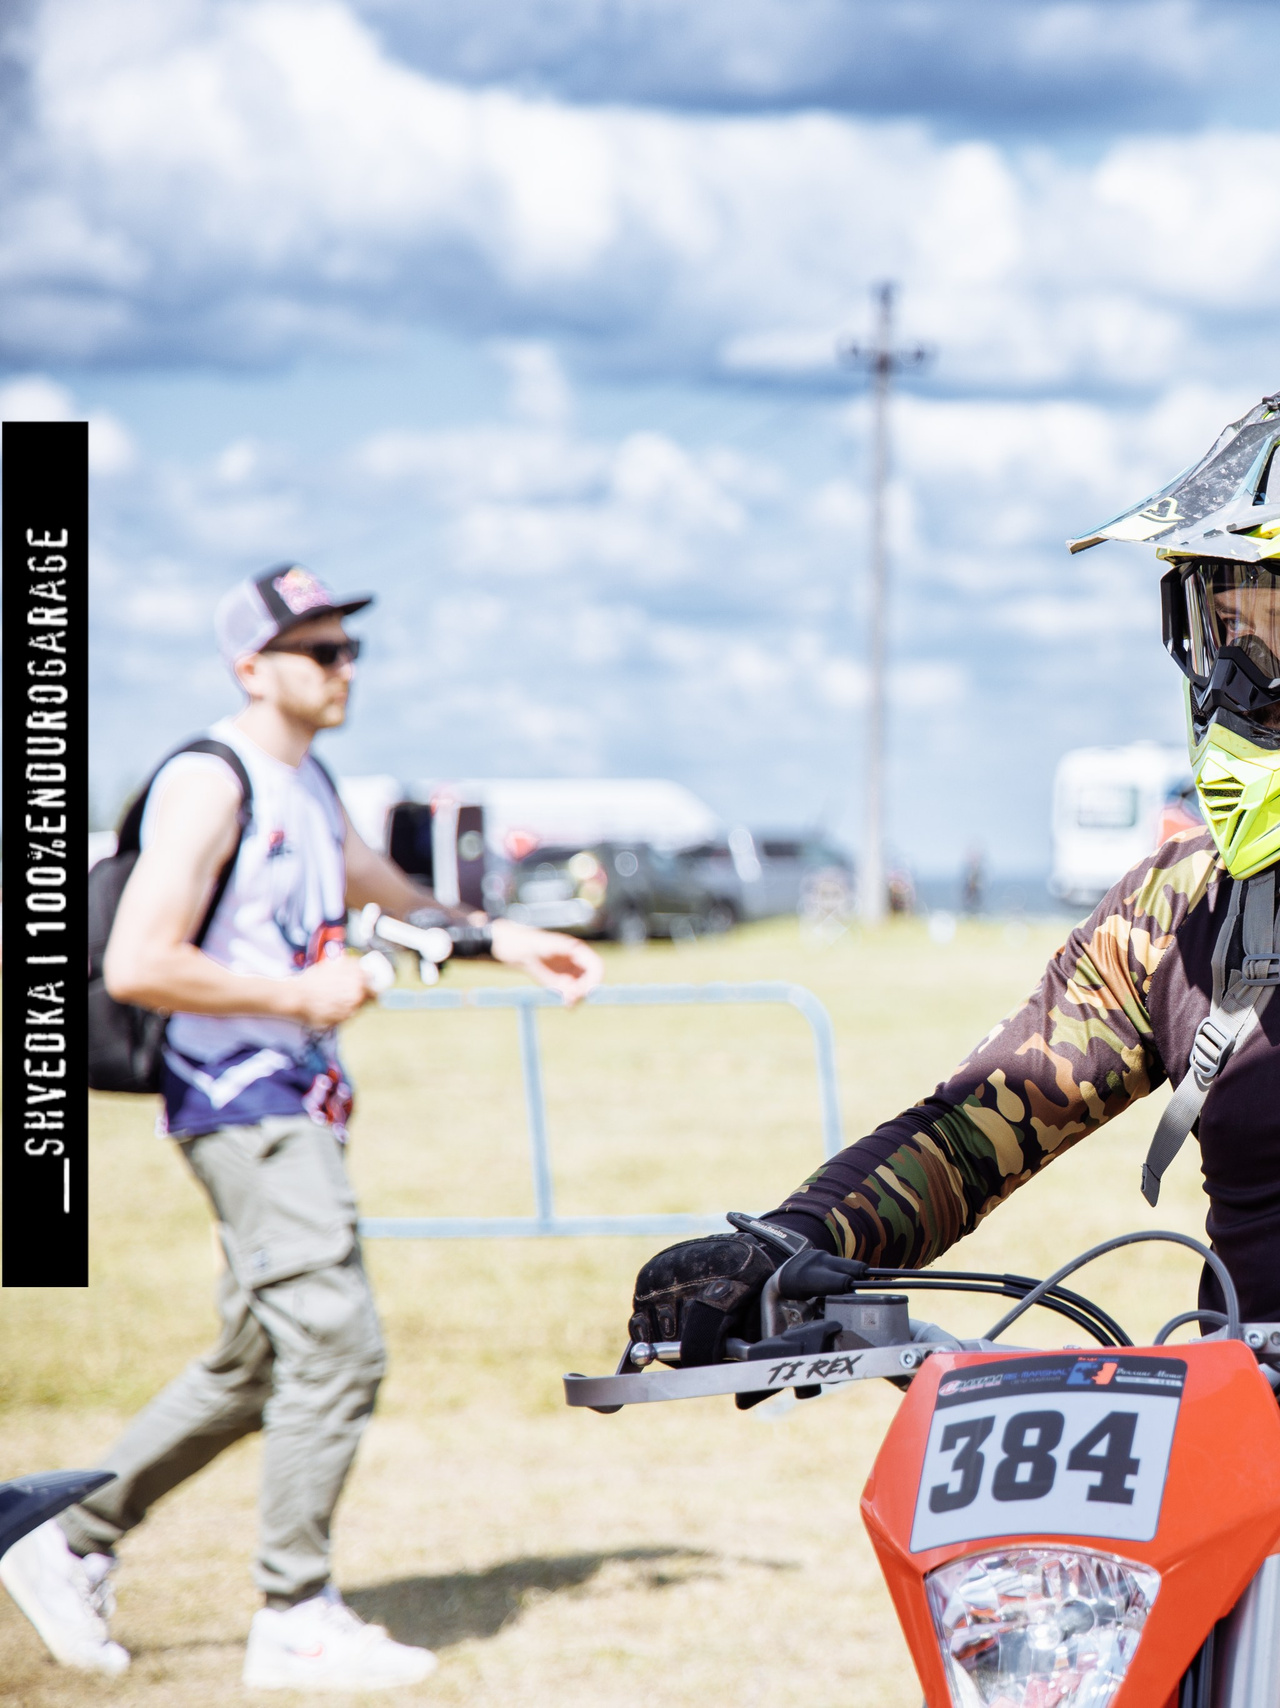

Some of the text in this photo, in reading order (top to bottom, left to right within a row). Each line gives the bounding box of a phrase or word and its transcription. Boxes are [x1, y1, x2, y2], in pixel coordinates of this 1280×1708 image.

[767, 1354, 864, 1385] TI REX
[928, 1409, 1141, 1514] 384
